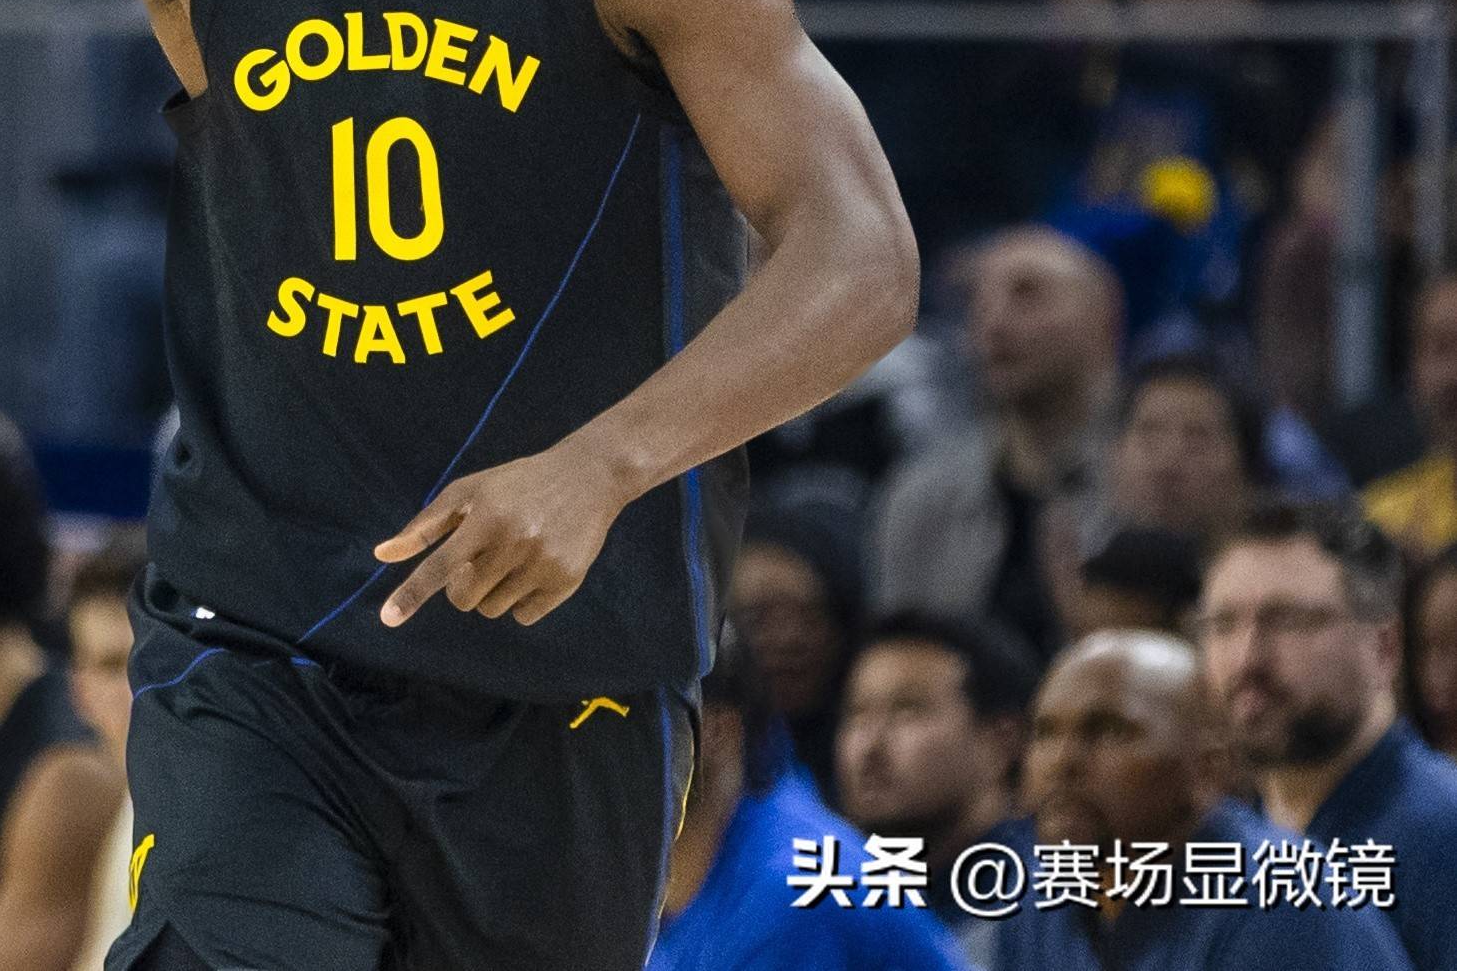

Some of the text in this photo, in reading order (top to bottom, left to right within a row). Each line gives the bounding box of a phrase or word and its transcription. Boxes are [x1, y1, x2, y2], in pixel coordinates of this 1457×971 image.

[233, 11, 541, 113] GOLDEN
[331, 116, 445, 261] 10
[266, 270, 516, 364] STATE
